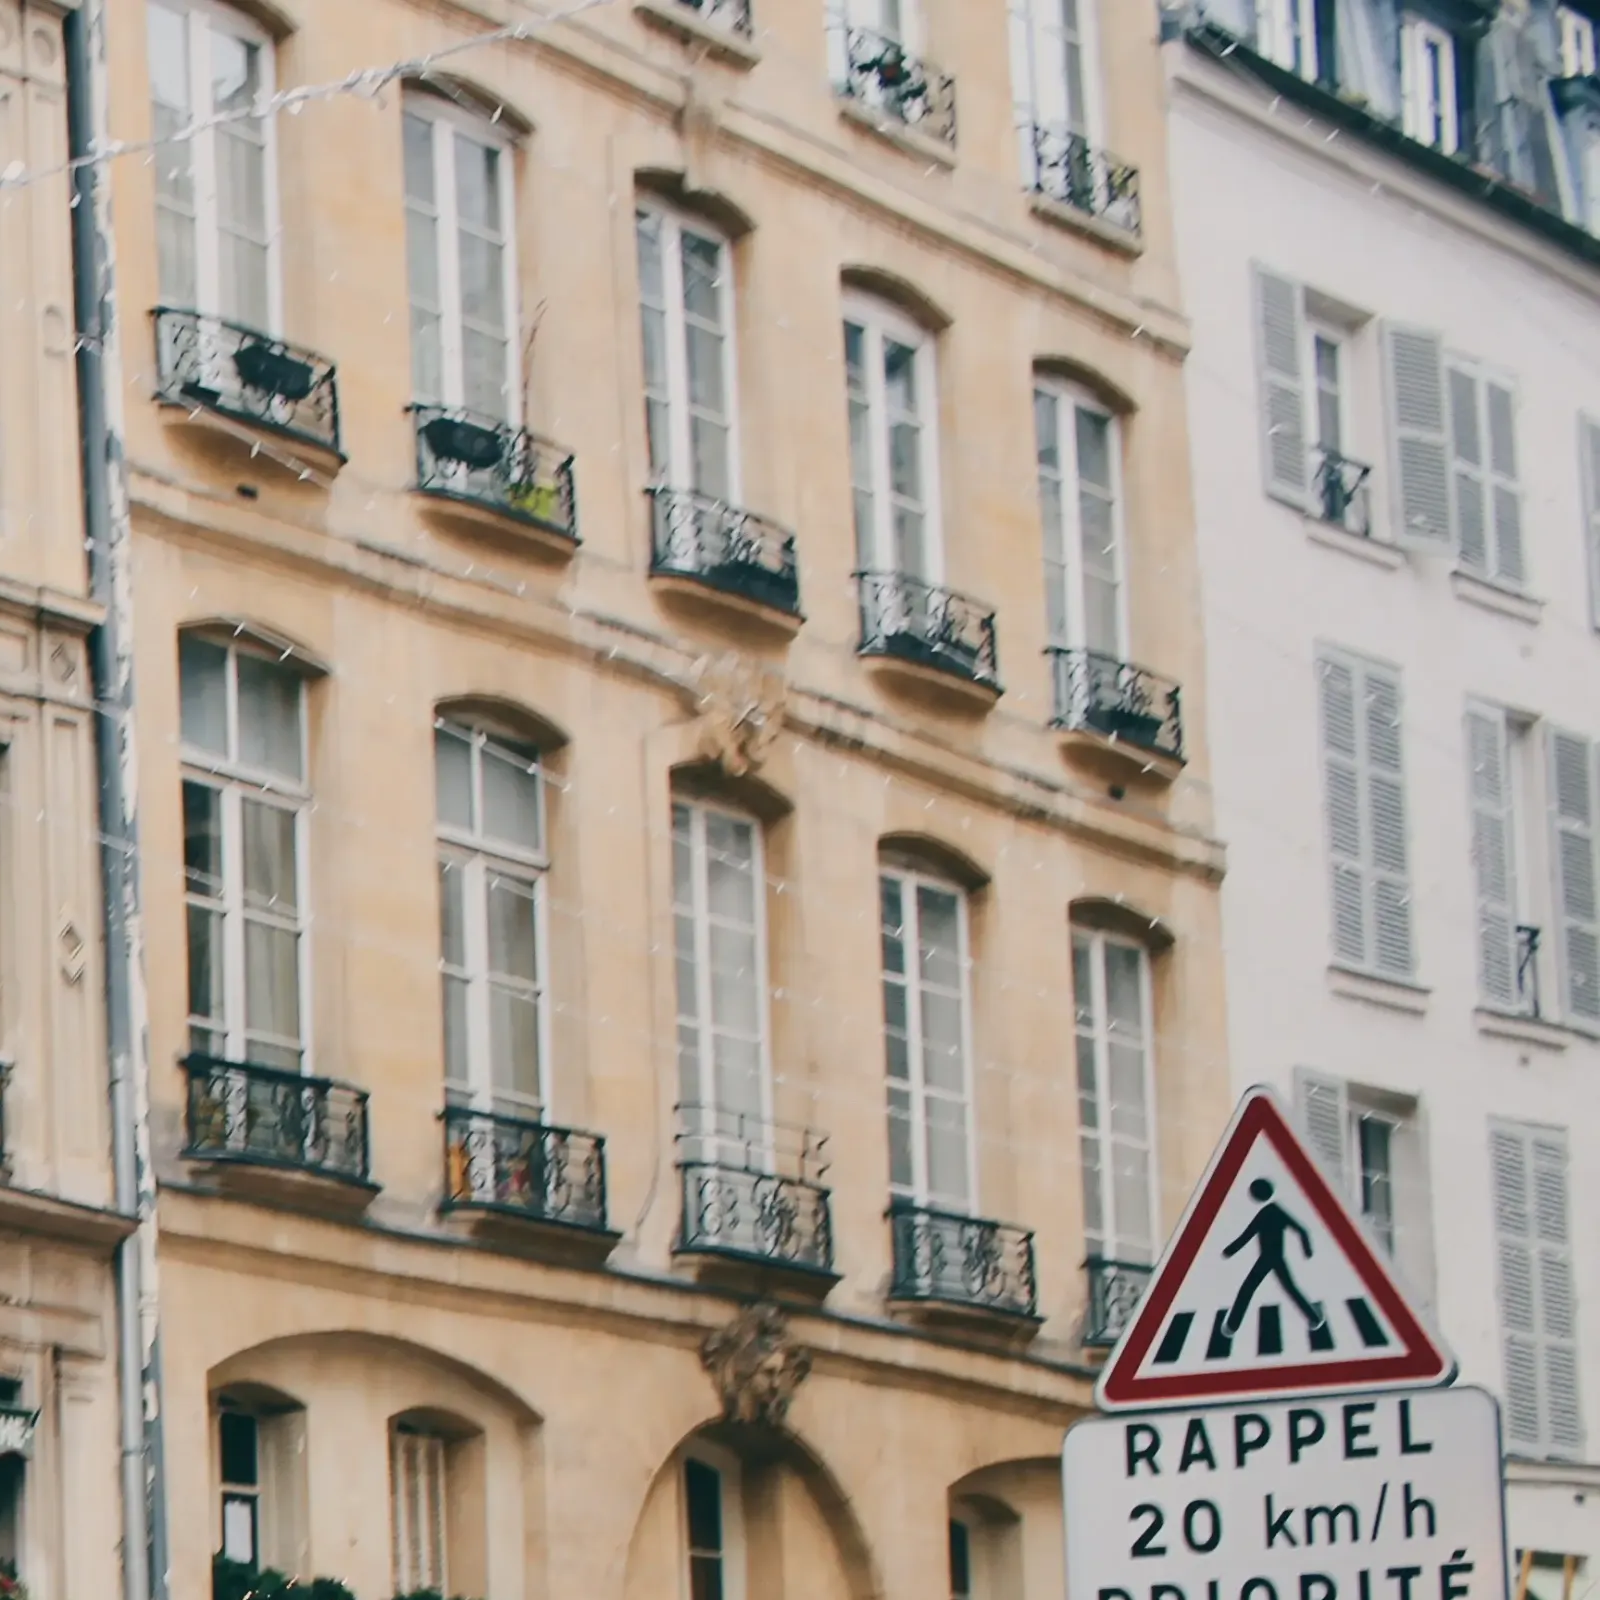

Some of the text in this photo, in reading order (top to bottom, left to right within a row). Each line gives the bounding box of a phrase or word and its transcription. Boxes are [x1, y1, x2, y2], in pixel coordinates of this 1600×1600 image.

[1124, 1399, 1433, 1478] RAPPEL
[1129, 1481, 1437, 1559] 20 km/h
